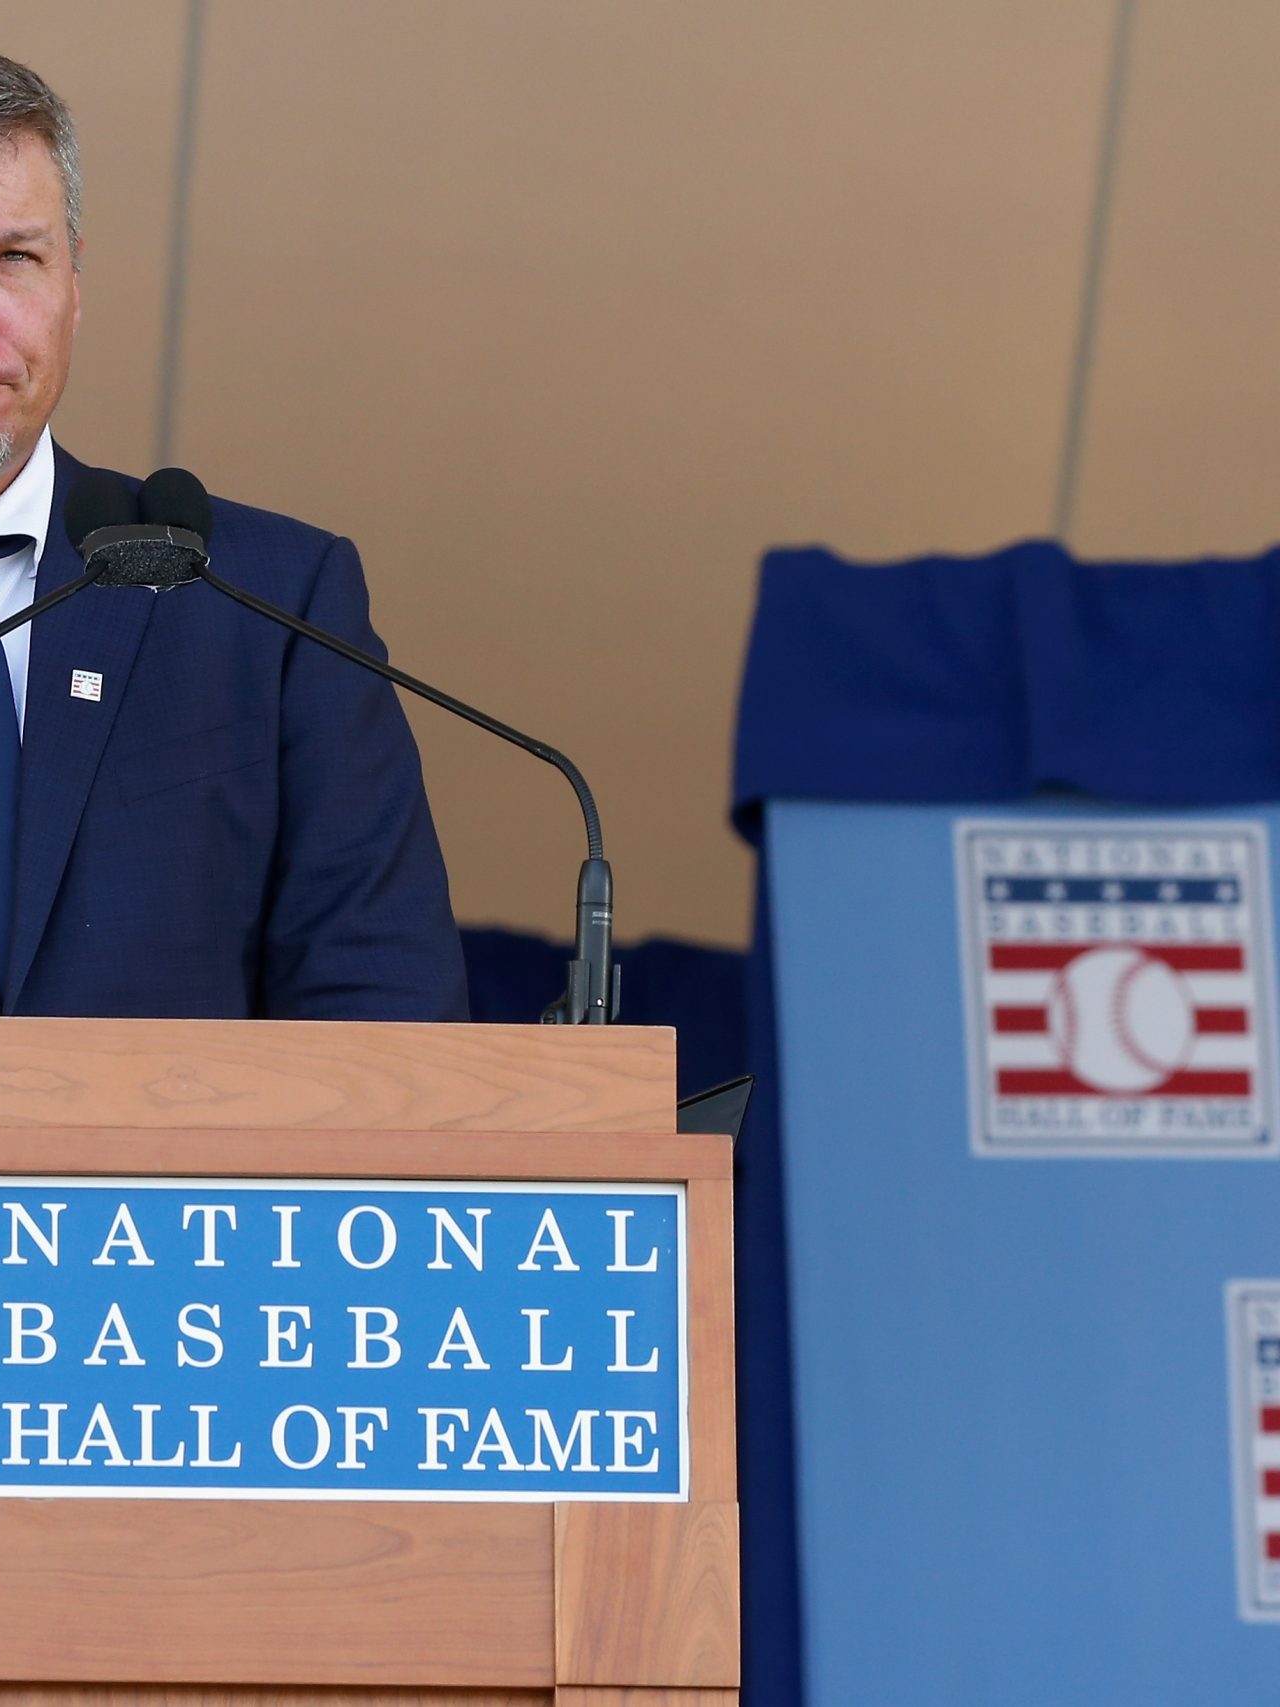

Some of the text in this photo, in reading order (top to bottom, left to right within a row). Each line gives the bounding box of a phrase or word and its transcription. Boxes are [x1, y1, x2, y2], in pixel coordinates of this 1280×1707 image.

[1, 1202, 658, 1272] NATIONAL
[1, 1302, 659, 1372] BASEBALL
[1, 1402, 659, 1473] HALL OF FAME
